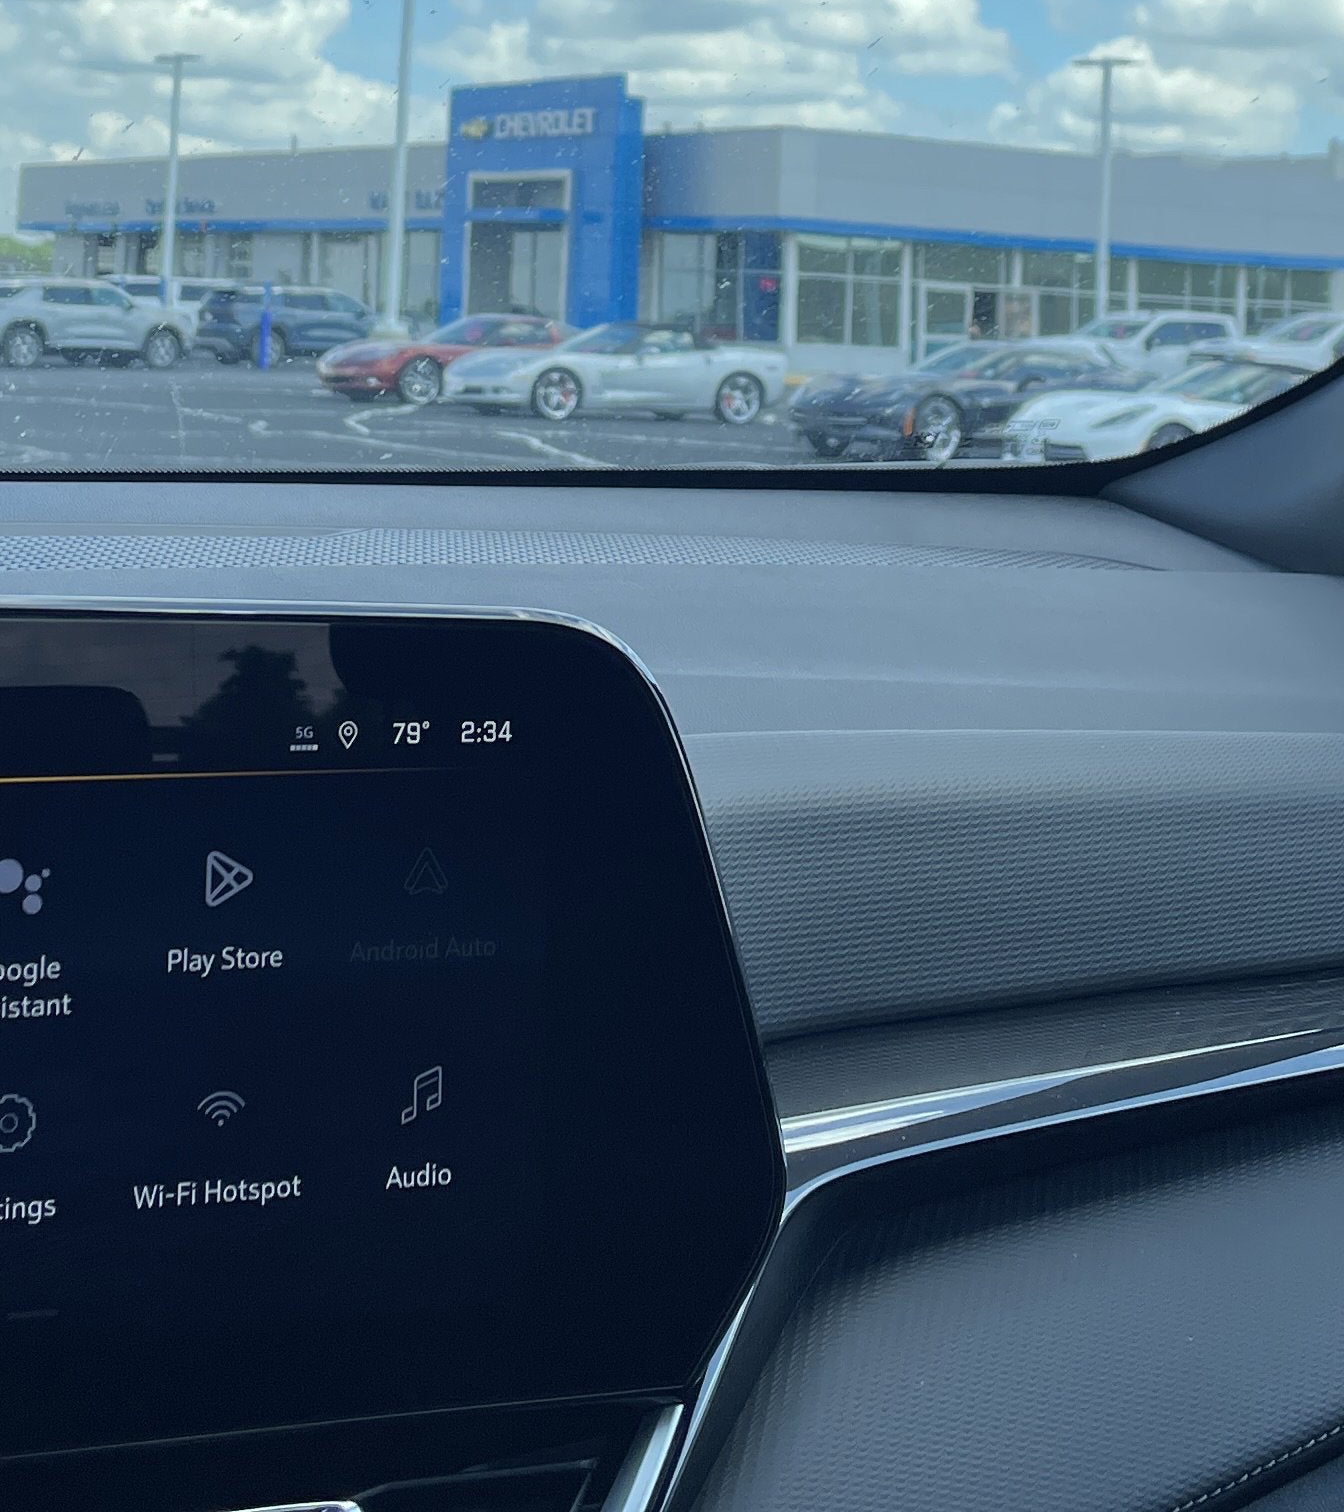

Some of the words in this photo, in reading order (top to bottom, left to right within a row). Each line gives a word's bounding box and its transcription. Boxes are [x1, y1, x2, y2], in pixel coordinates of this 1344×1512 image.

[494, 108, 596, 140] CHEVROLET
[295, 725, 314, 739] 5G
[392, 720, 430, 745] 79°
[460, 720, 513, 744] 2:34
[167, 947, 216, 978] Play
[221, 945, 284, 970] Store
[350, 938, 439, 962] Android
[444, 937, 498, 959] Auto
[385, 1161, 453, 1190] Audio
[133, 1181, 197, 1210] Wi-Fi
[204, 1174, 302, 1207] Hotspot
